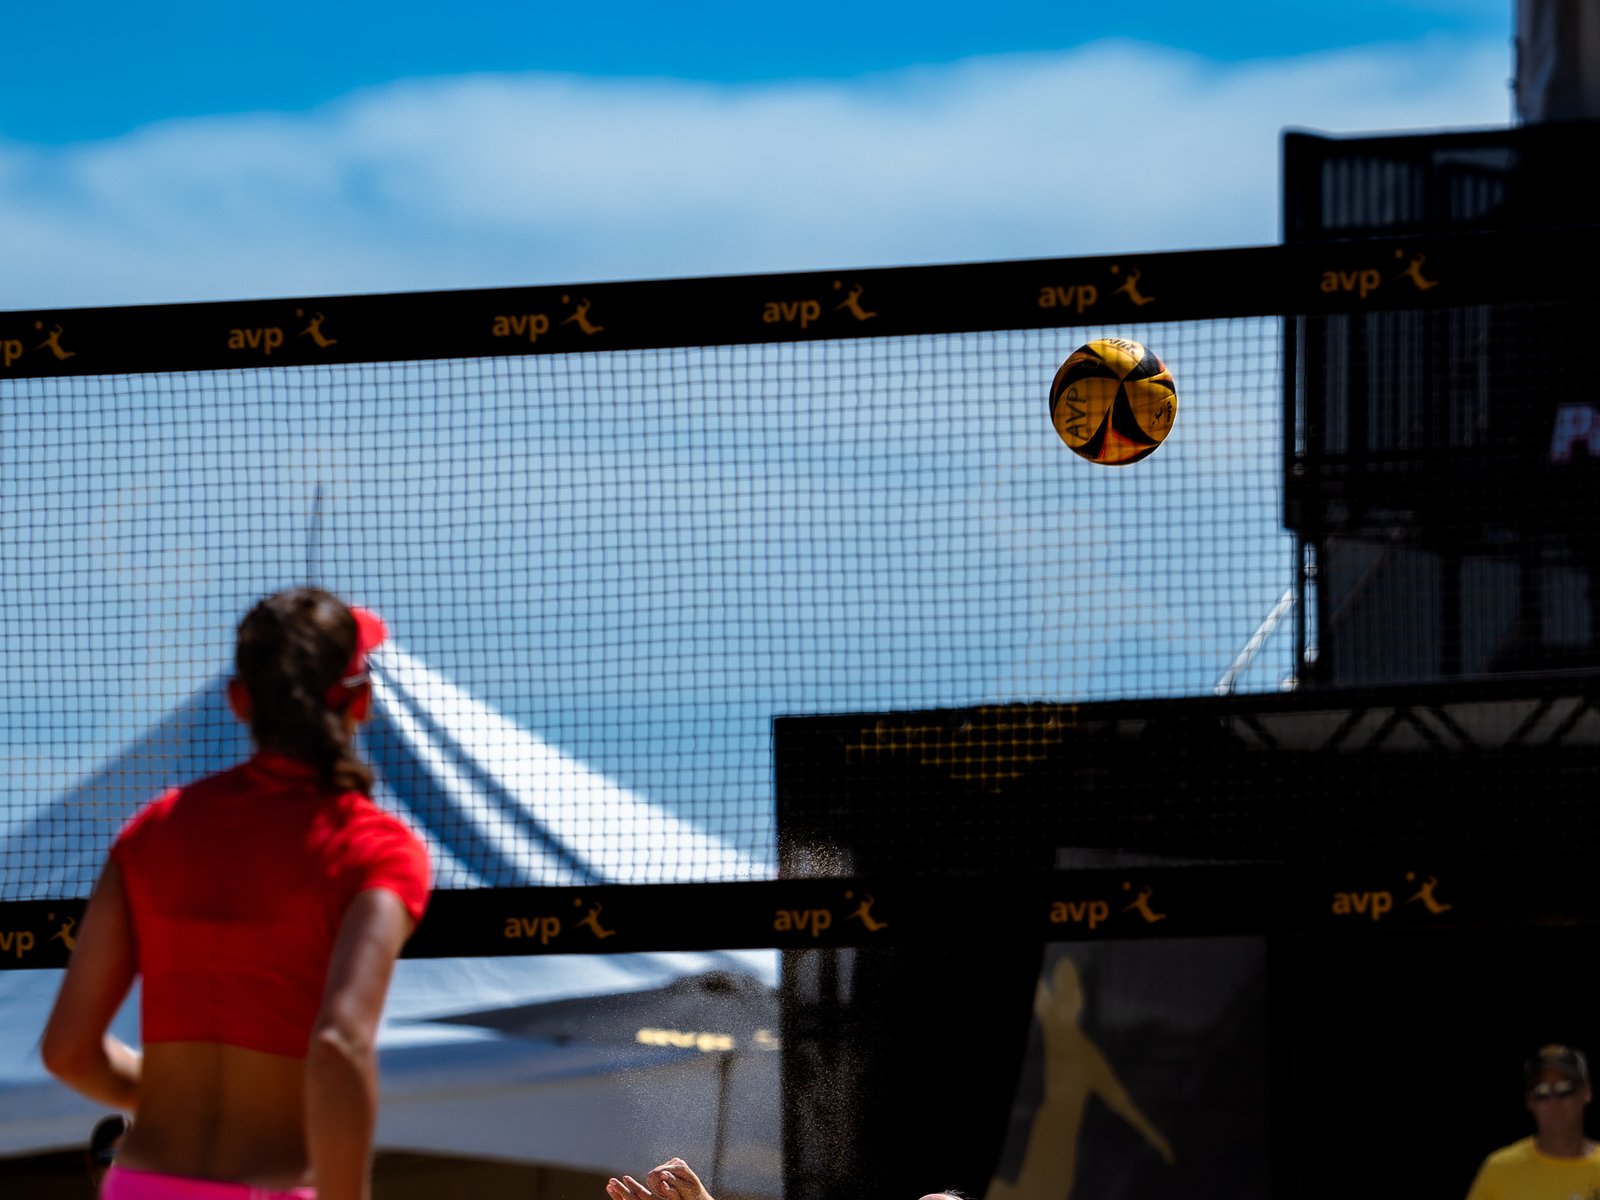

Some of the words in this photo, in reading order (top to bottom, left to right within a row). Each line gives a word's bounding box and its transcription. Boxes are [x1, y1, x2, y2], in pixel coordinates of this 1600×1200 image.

[1320, 269, 1381, 299] avp
[762, 299, 821, 328] avp
[1038, 284, 1098, 314] avp
[227, 327, 284, 355] avp
[493, 314, 549, 342] avp
[1066, 387, 1089, 441] AVP
[1049, 900, 1109, 930] avp
[1331, 890, 1393, 921] avp
[504, 917, 560, 945] avp
[774, 909, 831, 938] avp
